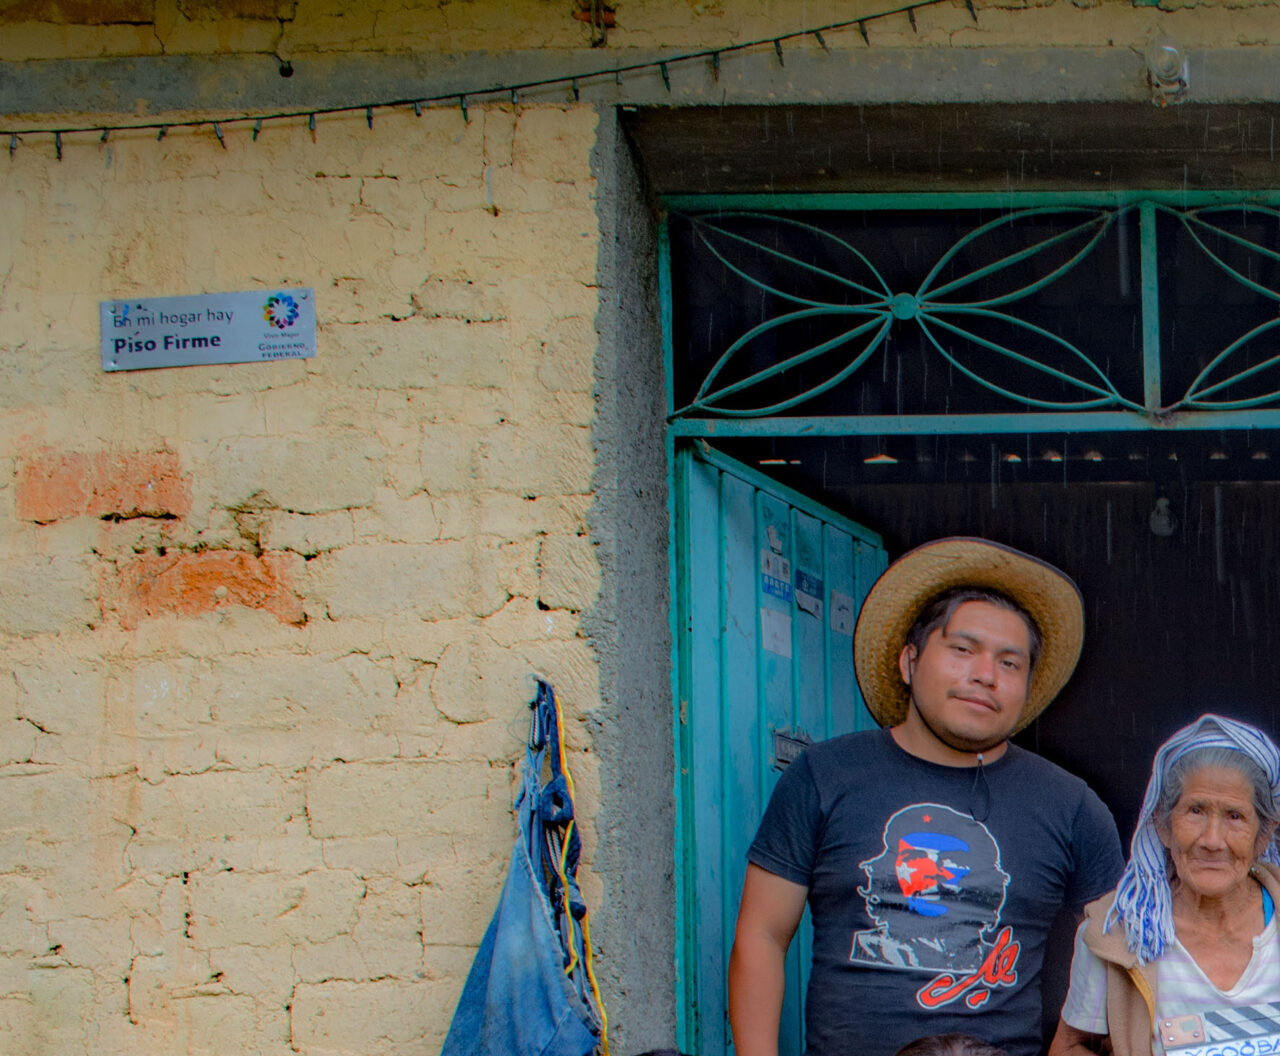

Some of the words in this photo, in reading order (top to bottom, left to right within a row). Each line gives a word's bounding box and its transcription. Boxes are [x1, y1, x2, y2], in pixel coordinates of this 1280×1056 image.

[113, 315, 132, 328] En
[136, 312, 155, 326] mi
[160, 311, 202, 327] hogar
[206, 307, 234, 325] hay
[113, 336, 157, 354] Piso
[163, 333, 222, 350] Firme
